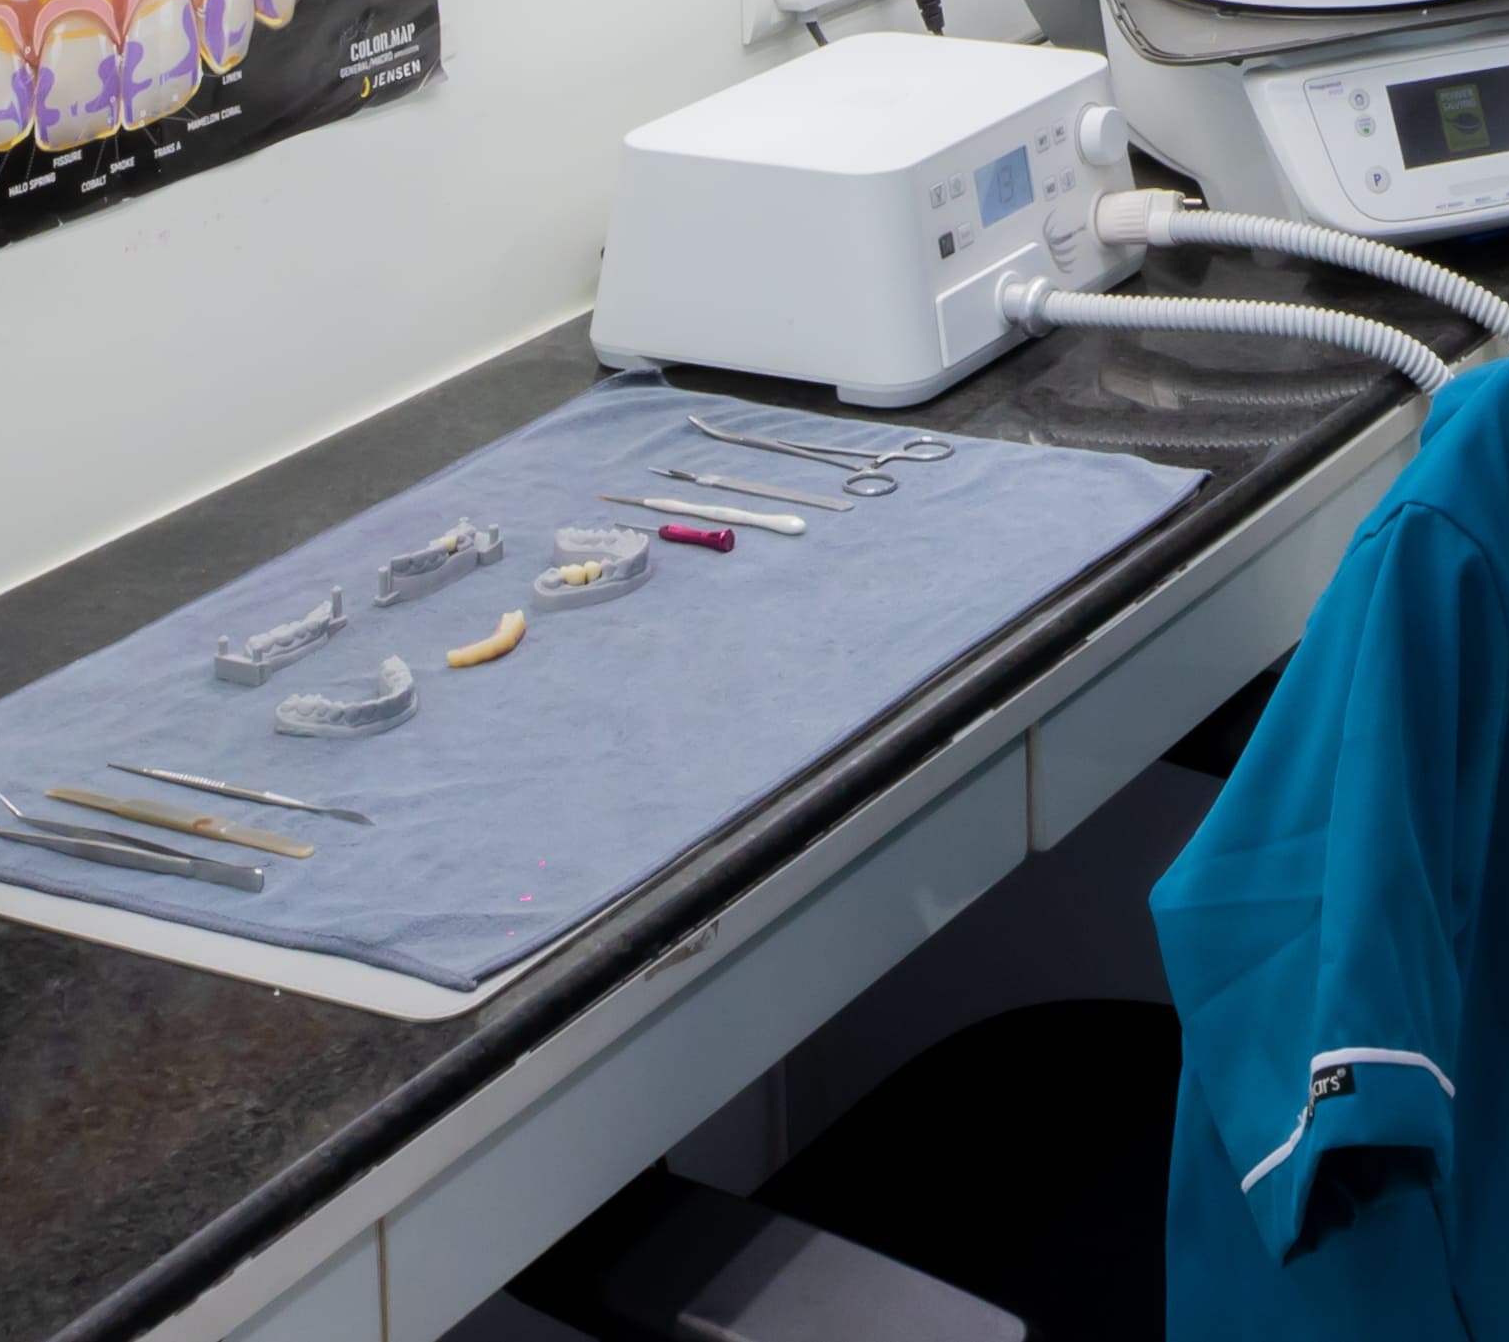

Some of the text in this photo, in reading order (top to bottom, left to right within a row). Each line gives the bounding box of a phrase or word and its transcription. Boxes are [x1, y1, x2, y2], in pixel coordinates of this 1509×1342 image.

[372, 58, 421, 89] JENSEN
[53, 149, 83, 168] FISSURE
[153, 140, 182, 159] TRANS A
[110, 156, 135, 174] SMOKE
[9, 172, 56, 197] HALO SPRING
[81, 174, 107, 193] COBALT
[1373, 173, 1382, 187] P
[1312, 1075, 1341, 1097] ars
